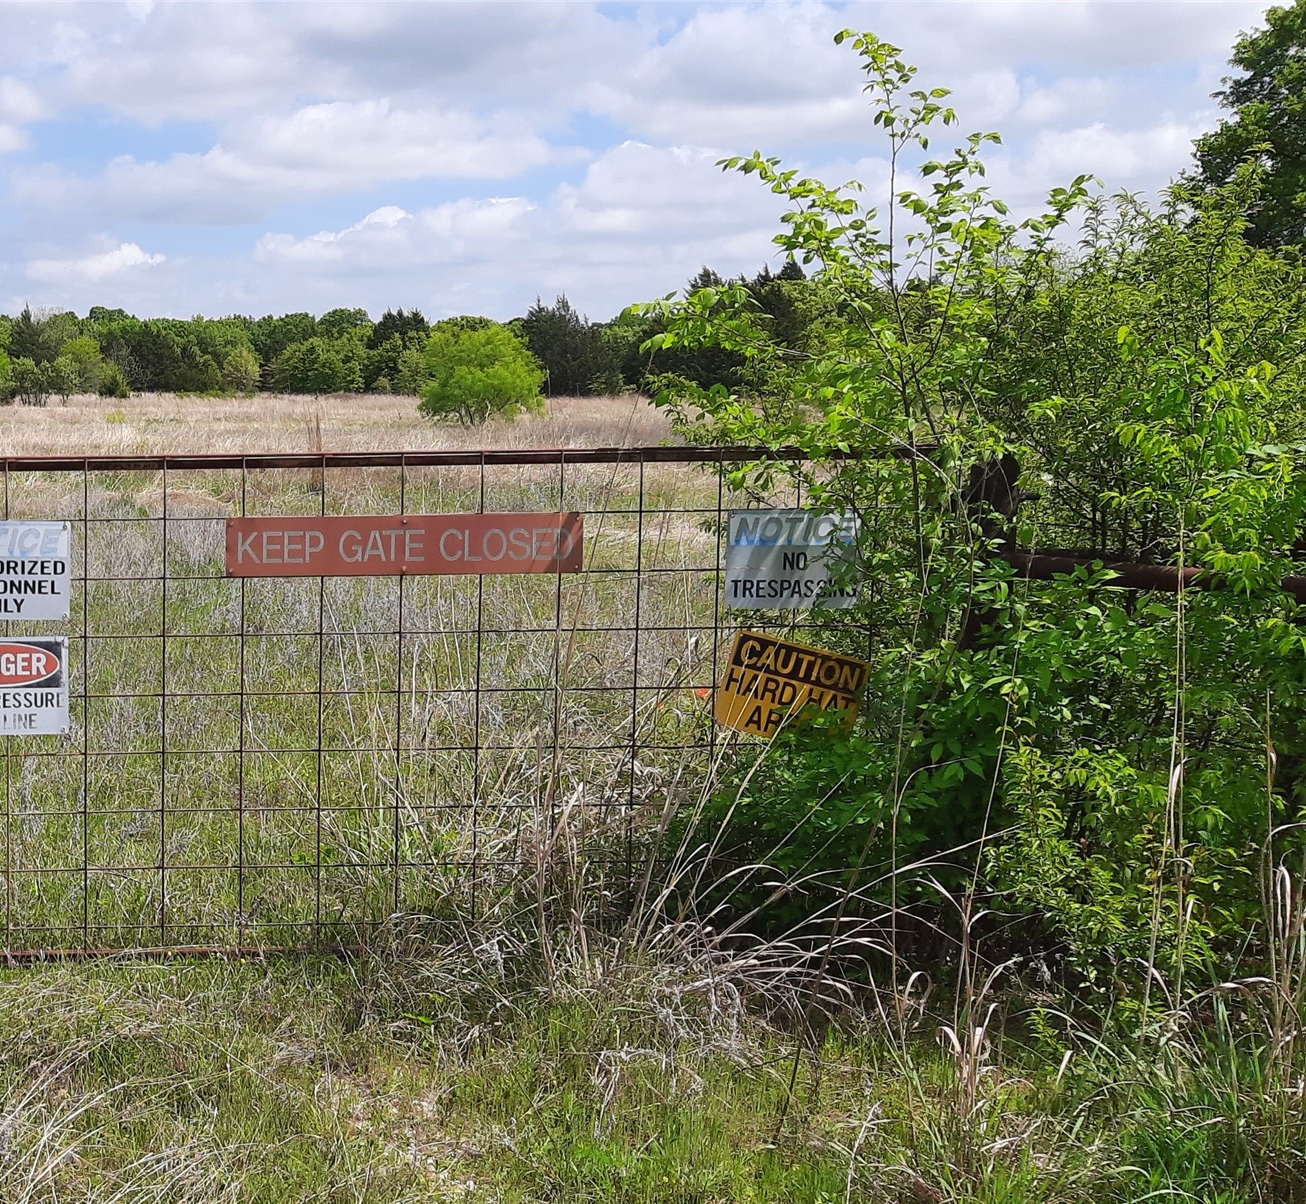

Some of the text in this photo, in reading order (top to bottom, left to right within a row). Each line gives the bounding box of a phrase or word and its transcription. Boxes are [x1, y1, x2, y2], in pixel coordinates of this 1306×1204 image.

[237, 527, 574, 564] KEEP GATE CLOSED
[735, 516, 855, 546] NOTICE
[783, 552, 808, 571] NO
[740, 639, 862, 692] CAUTION
[724, 667, 798, 707] HARD
